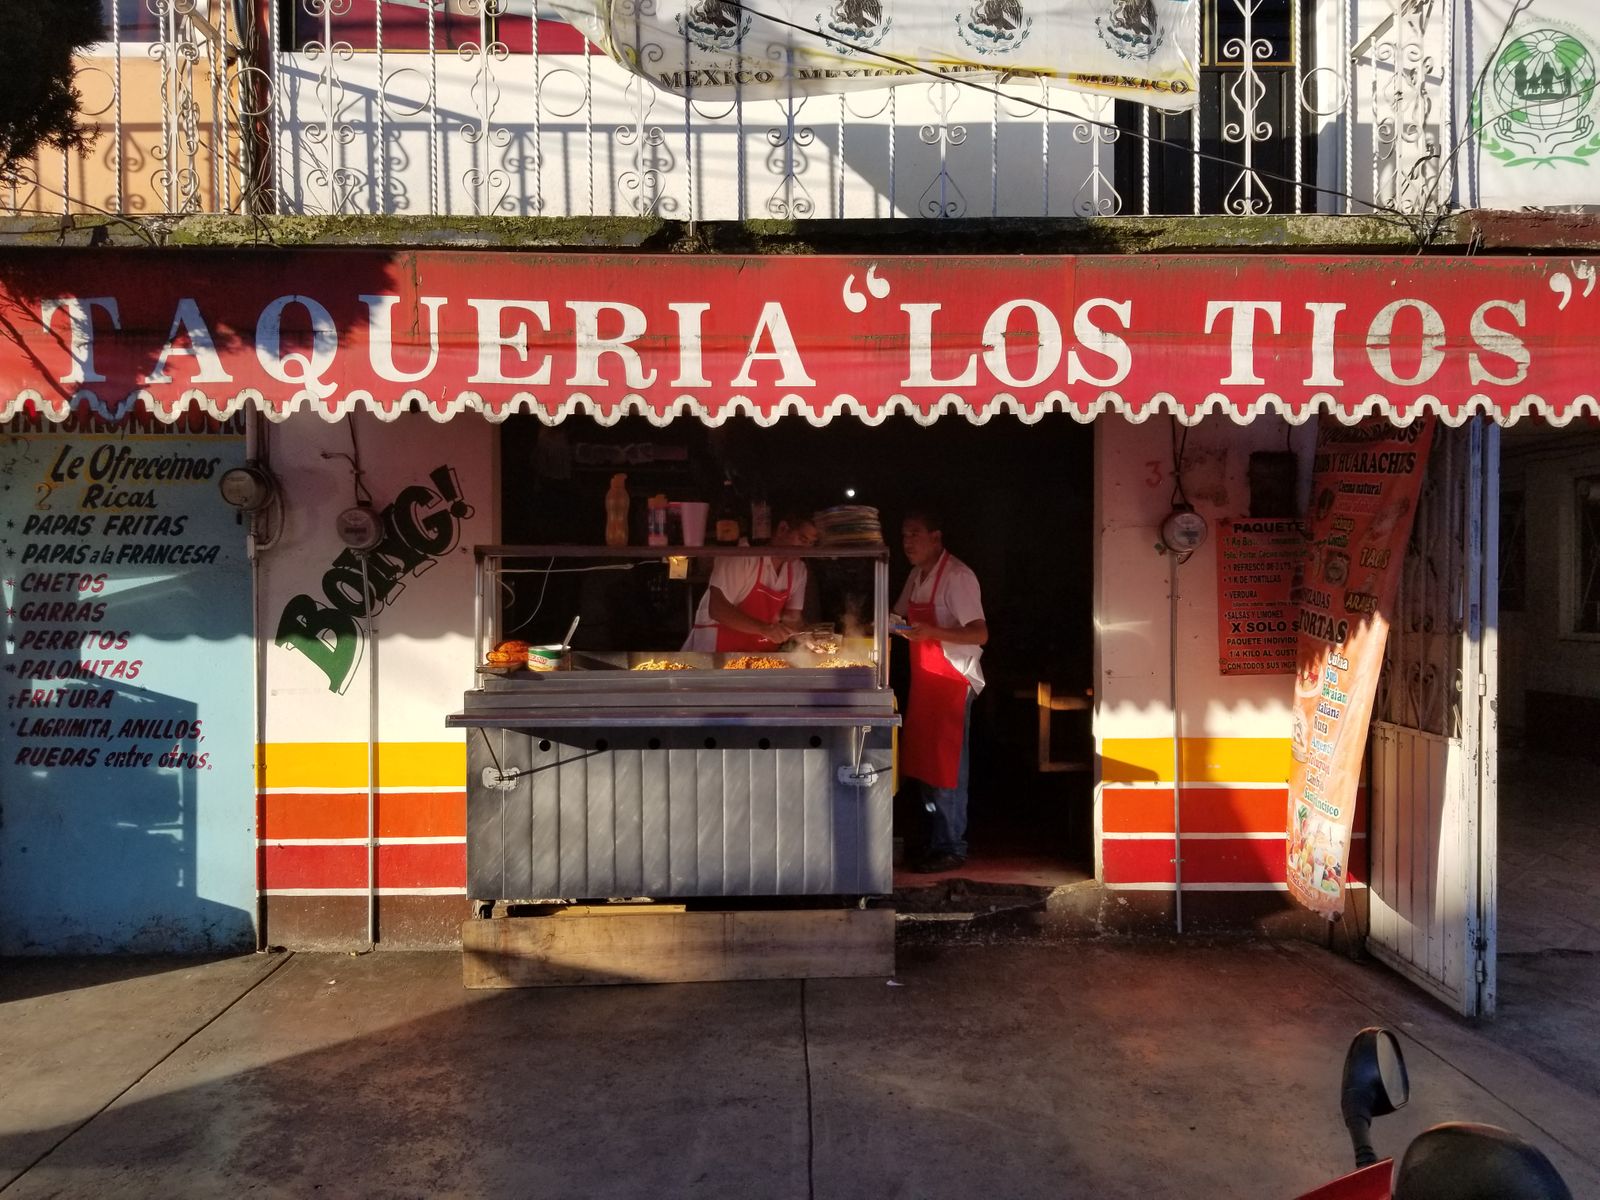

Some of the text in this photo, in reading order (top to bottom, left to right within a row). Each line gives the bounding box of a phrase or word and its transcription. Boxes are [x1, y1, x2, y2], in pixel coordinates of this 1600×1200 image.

[659, 68, 774, 88] MEXICO
[41, 294, 818, 398] TAQUERIA
[51, 443, 221, 484] Le Ofrecemos
[82, 483, 158, 509] Ricas
[22, 514, 189, 537] PAPAS FRITAS
[1233, 521, 1305, 534] PAQUETE
[21, 543, 221, 565] PAPAS a la FRANCESA
[1233, 563, 1265, 571] REFRESCO
[20, 572, 108, 593] CHETOS
[1239, 575, 1248, 584] DE
[1249, 574, 1281, 583] TORTILLAS
[1229, 590, 1258, 599] VERDURA
[19, 601, 106, 623] GARRAS
[1227, 610, 1250, 619] SALSAS
[1231, 622, 1242, 633] X
[1246, 621, 1287, 633] SOLO
[1299, 609, 1348, 644] TORTAS
[19, 629, 130, 651] PERRITOS
[1227, 637, 1262, 645] PAQUETE
[1263, 649, 1273, 657] AL
[17, 659, 143, 681] PALOMITAS
[1227, 663, 1241, 671] CON
[1242, 662, 1265, 670] TODOS
[1266, 661, 1280, 669] SUS
[17, 688, 115, 710] FRITURA
[16, 717, 206, 743] LAGRIMITA, ANILLOS,
[15, 744, 213, 770] RUEDAS entre otros.
